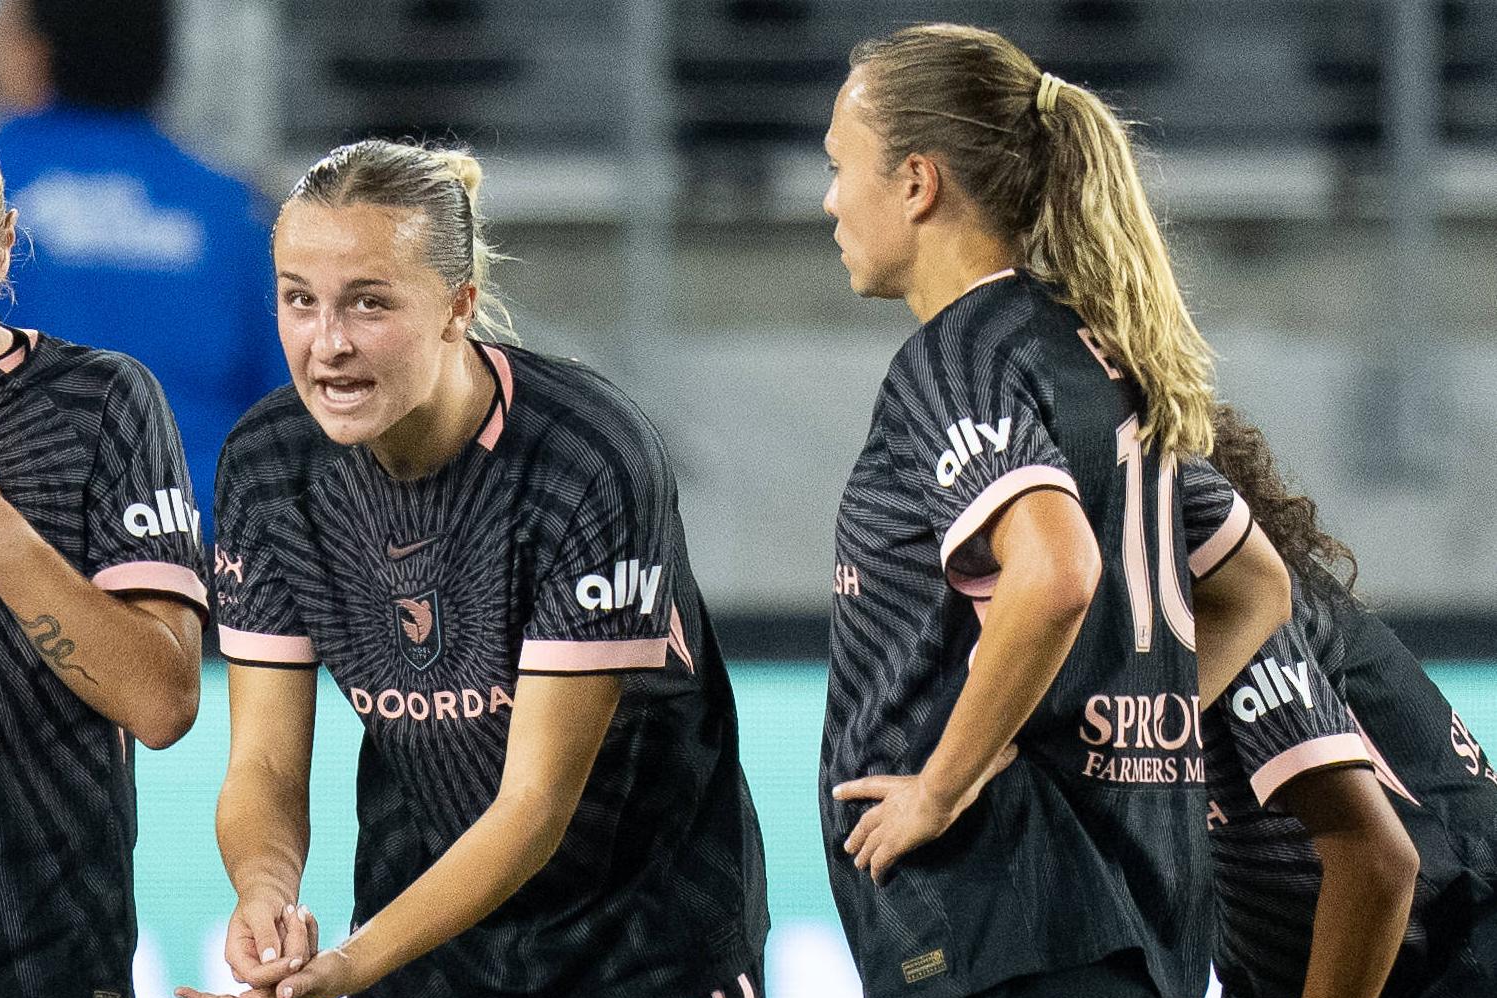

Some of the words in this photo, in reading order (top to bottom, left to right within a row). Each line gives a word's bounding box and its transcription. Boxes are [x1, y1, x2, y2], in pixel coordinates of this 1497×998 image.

[937, 417, 1012, 487] ally
[576, 559, 662, 614] ally
[350, 685, 514, 721] DOORDA
[1232, 656, 1313, 723] ally
[1079, 692, 1203, 750] SPRO
[1082, 751, 1178, 783] FARMERS
